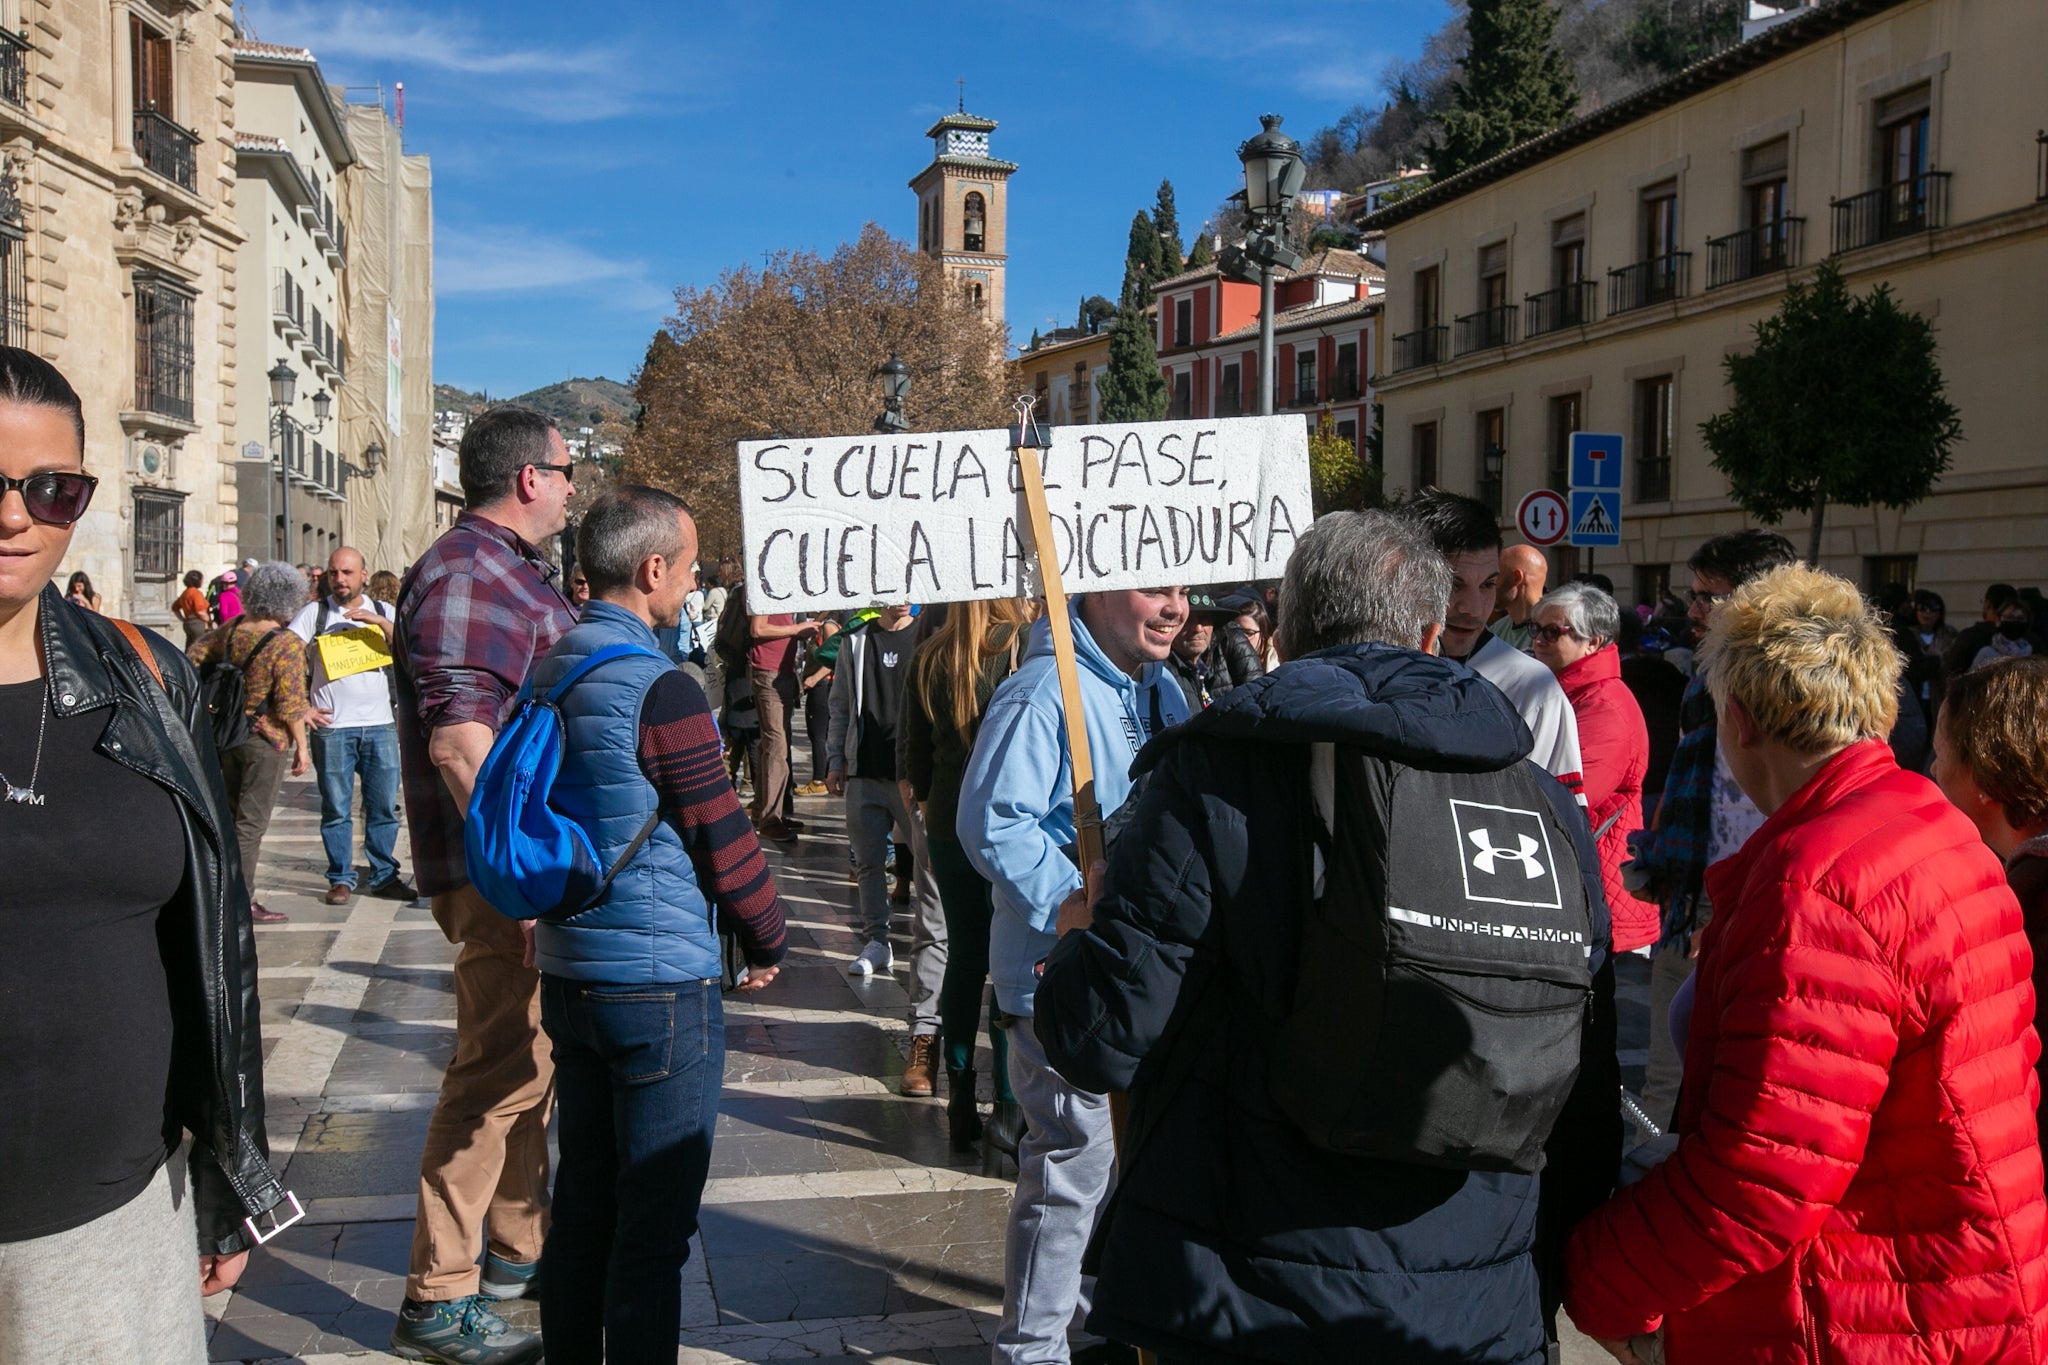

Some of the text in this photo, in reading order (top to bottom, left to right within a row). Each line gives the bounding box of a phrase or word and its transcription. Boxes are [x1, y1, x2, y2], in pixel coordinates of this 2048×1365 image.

[755, 445, 815, 502] Si
[833, 438, 991, 501] CUELA
[1080, 431, 1228, 492] PASE,
[757, 518, 941, 601] CUELA
[968, 516, 1031, 590] LA
[1430, 914, 1504, 937] UNDER
